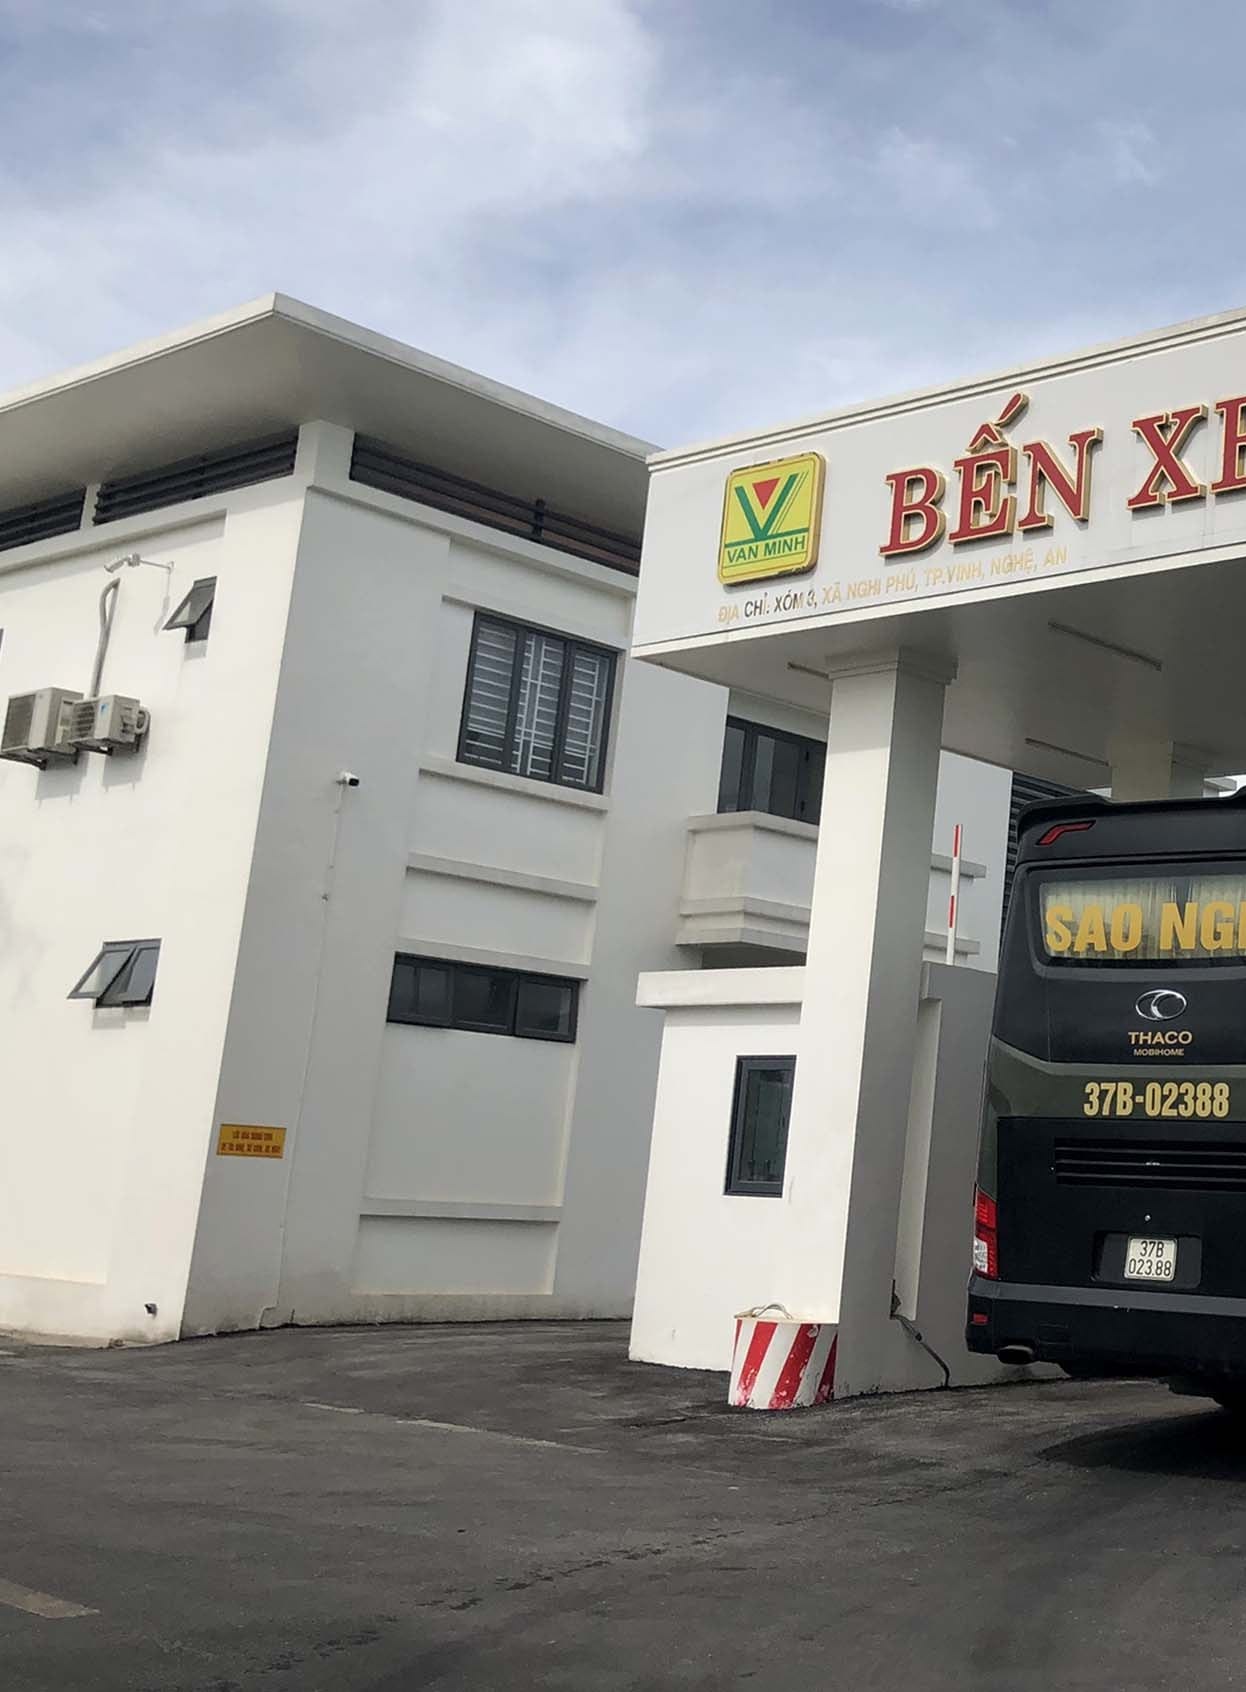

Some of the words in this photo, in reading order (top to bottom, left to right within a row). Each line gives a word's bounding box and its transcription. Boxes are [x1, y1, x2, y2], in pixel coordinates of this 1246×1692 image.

[878, 392, 1104, 558] BẾN
[763, 535, 806, 557] MINH
[774, 590, 804, 613] XÓM
[847, 578, 881, 601] NGHI
[1044, 545, 1068, 567] AN
[1045, 902, 1143, 953] SAO
[1128, 1031, 1193, 1045] THACO
[1133, 1048, 1185, 1057] MOBIHOME
[1083, 1081, 1230, 1118] 37B-02388
[1139, 1240, 1165, 1258] 37B
[1128, 1258, 1172, 1277] 023.88
